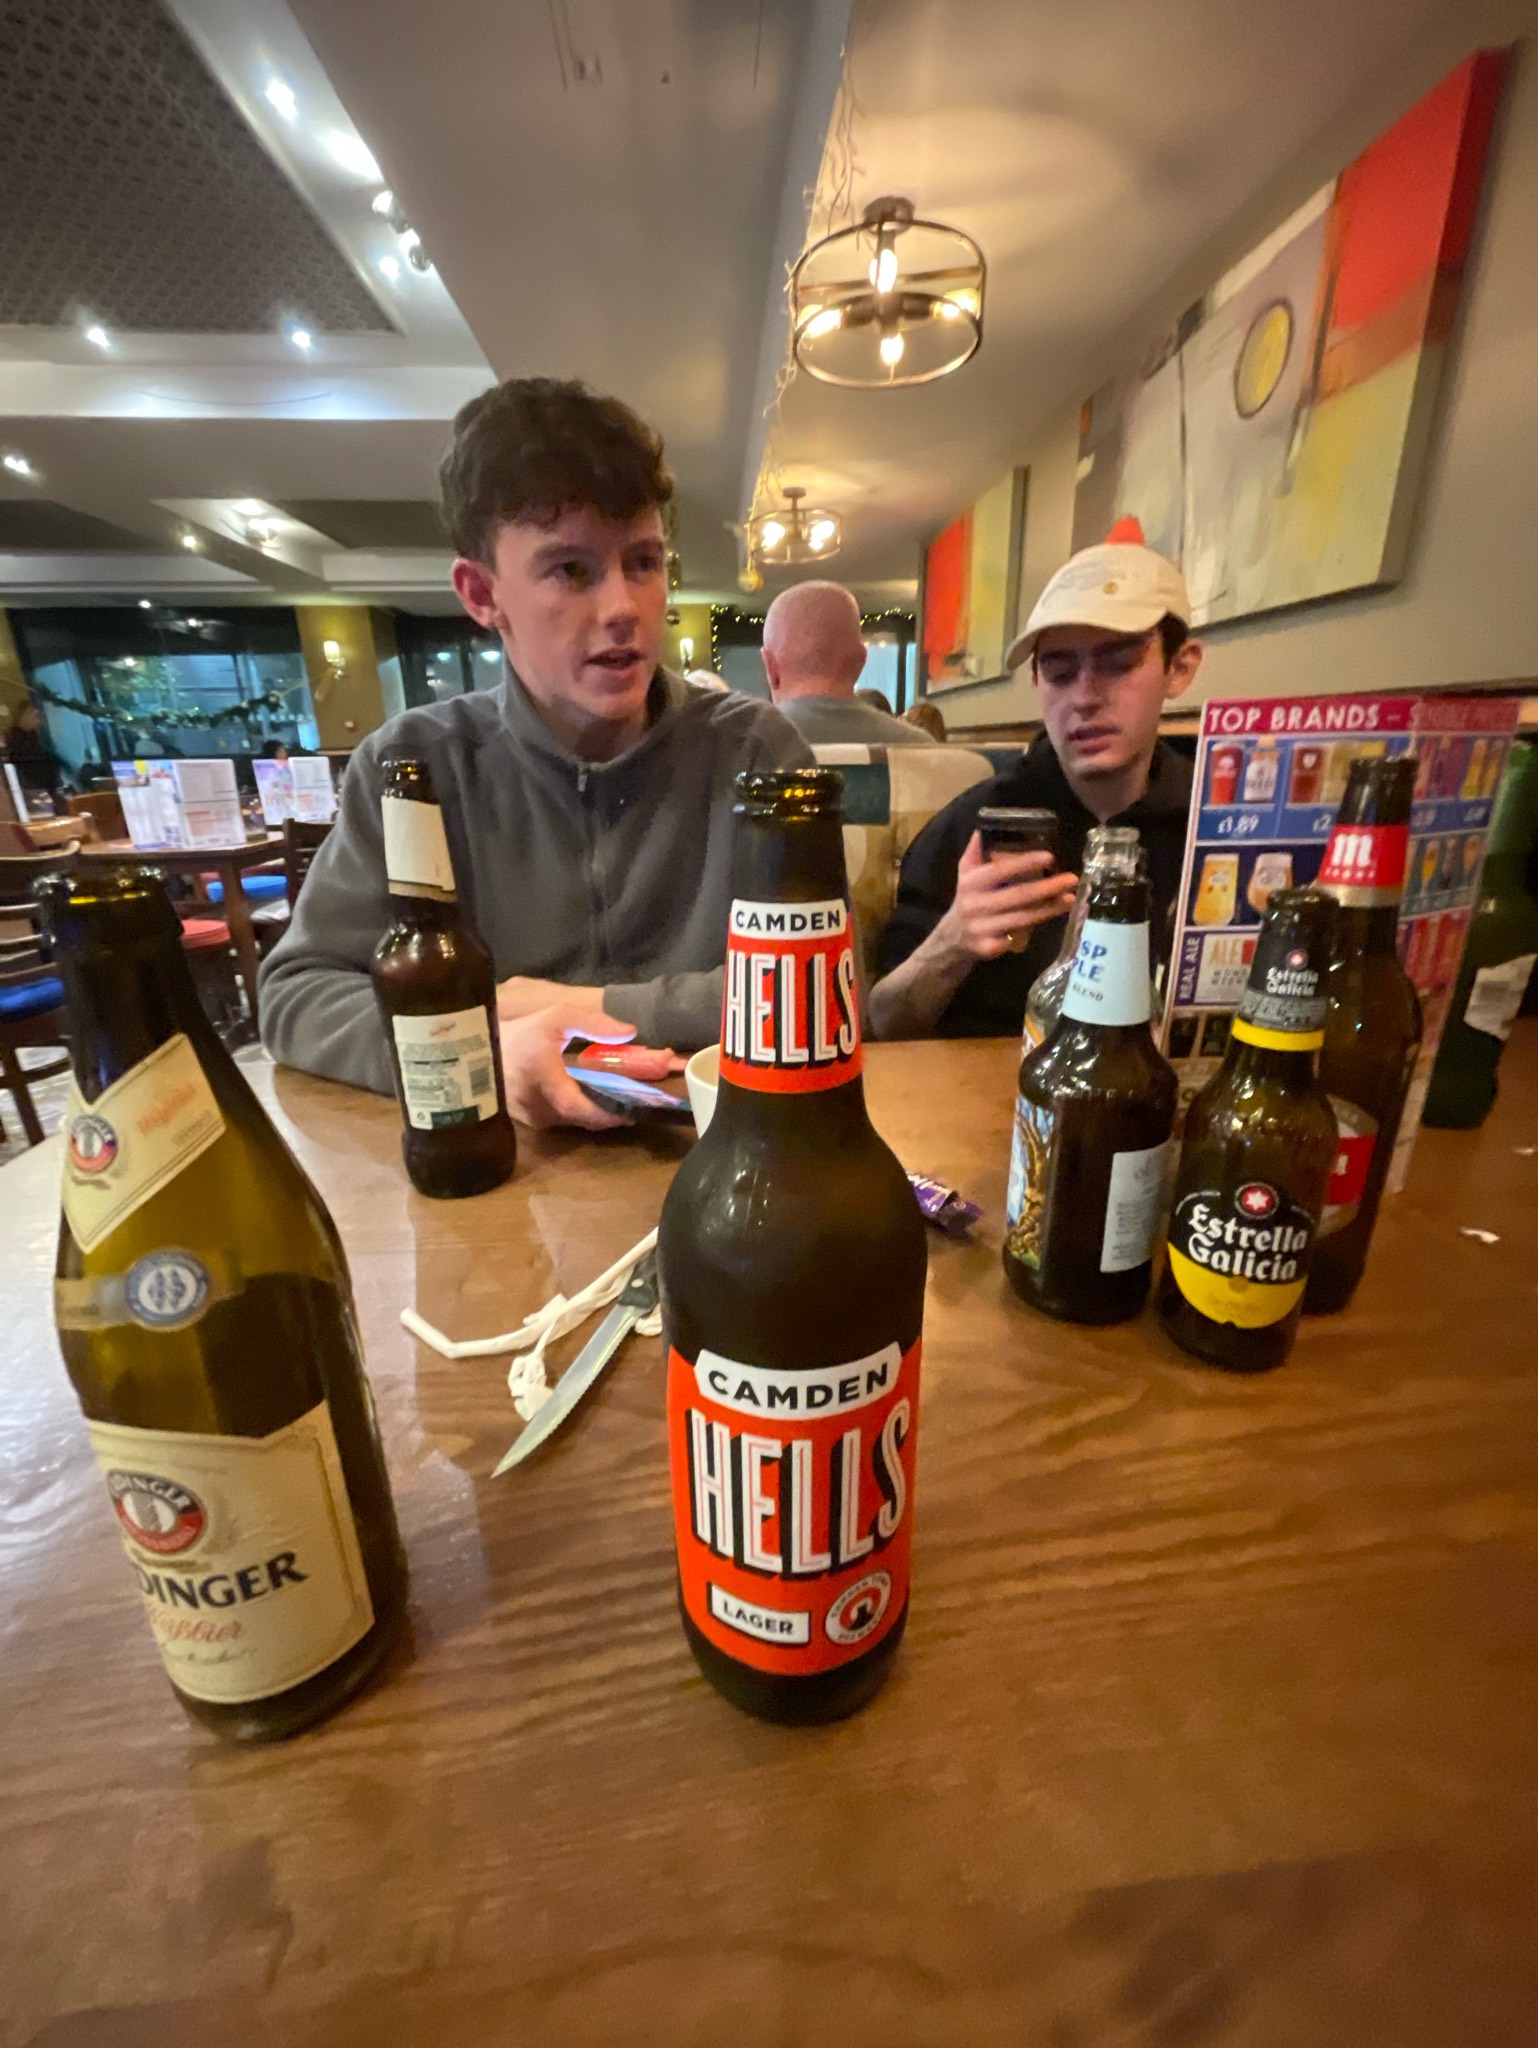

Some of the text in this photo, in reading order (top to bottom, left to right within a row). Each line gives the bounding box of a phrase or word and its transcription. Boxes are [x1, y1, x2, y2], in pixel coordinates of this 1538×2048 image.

[1207, 706, 1262, 732] TOP
[1270, 703, 1381, 730] BRANDS
[735, 909, 841, 932] CAMDEN
[1178, 937, 1201, 1000] REAL ALE
[1266, 966, 1319, 984] Estrella
[1266, 979, 1316, 997] Galicia
[724, 947, 857, 1070] HELLS
[1188, 1203, 1308, 1252] Estrella
[1188, 1232, 1298, 1281] Galicia
[707, 1361, 889, 1411] CAMDEN
[685, 1396, 911, 1581] HELLS
[722, 1600, 794, 1636] LAGER
